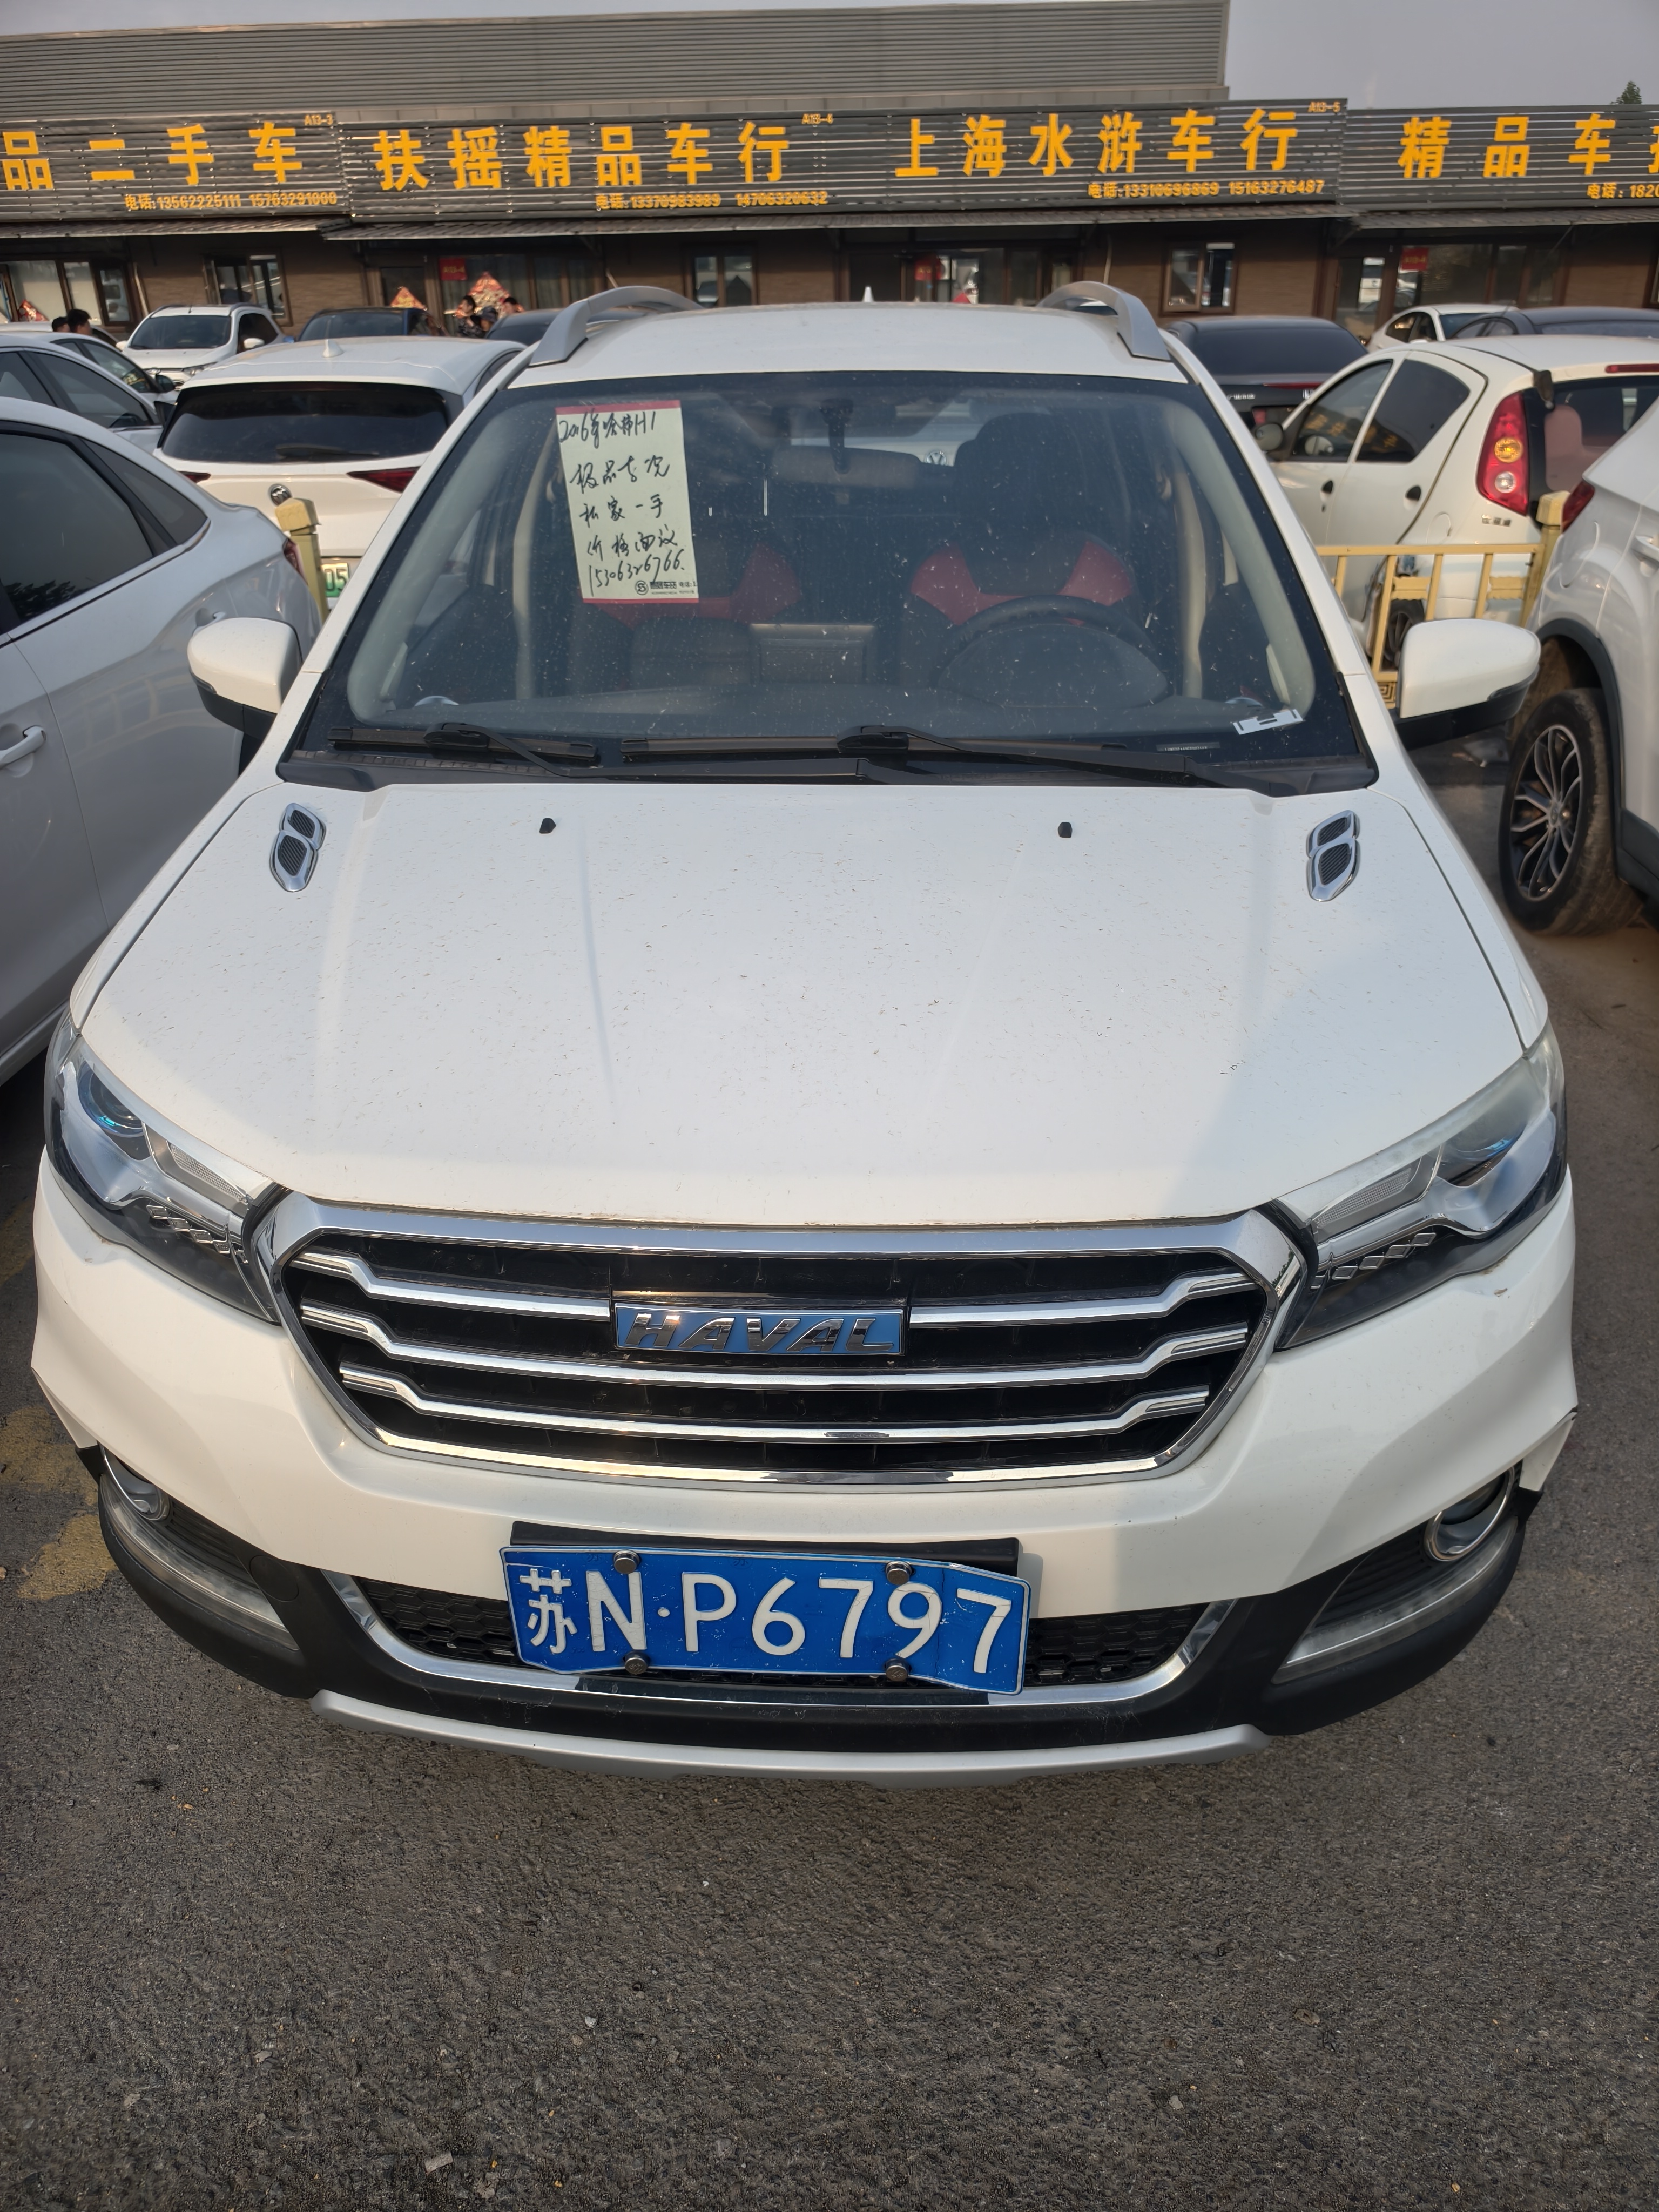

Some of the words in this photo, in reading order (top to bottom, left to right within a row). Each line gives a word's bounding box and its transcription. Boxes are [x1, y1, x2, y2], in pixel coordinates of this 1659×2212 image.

[304, 113, 333, 126] A13-3
[894, 109, 1298, 178] 上海水浒车行
[1398, 113, 1659, 179] 精品车
[2, 122, 302, 190] 品二手车
[373, 122, 789, 191] 扶摇精品车行
[624, 1313, 894, 1352] HAVAL
[520, 1568, 1011, 1674] 苏N·P6797
